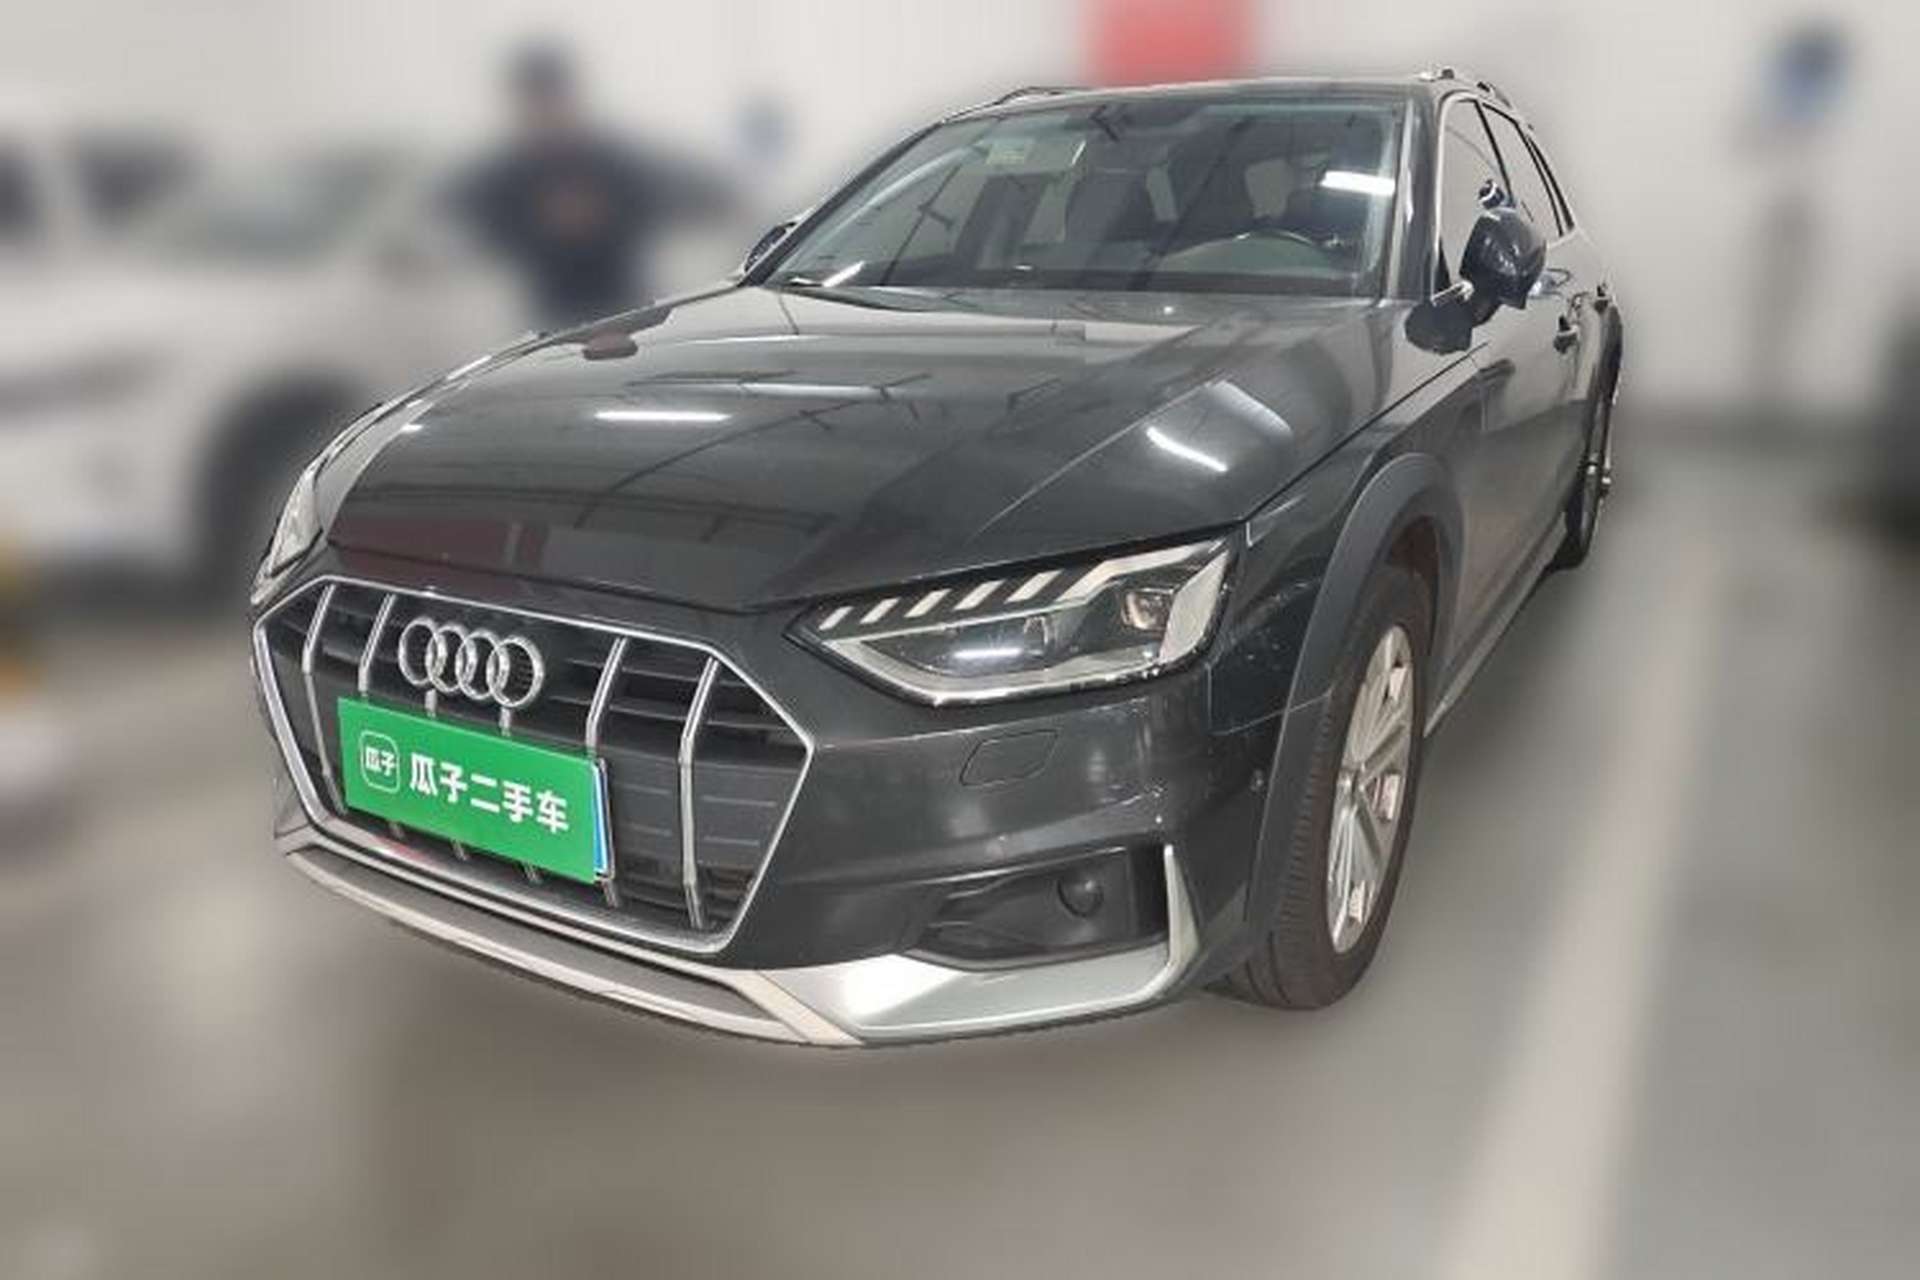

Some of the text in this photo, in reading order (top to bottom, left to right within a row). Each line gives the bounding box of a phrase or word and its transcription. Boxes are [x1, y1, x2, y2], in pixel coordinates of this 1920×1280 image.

[409, 752, 569, 833] 瓜子二手车
